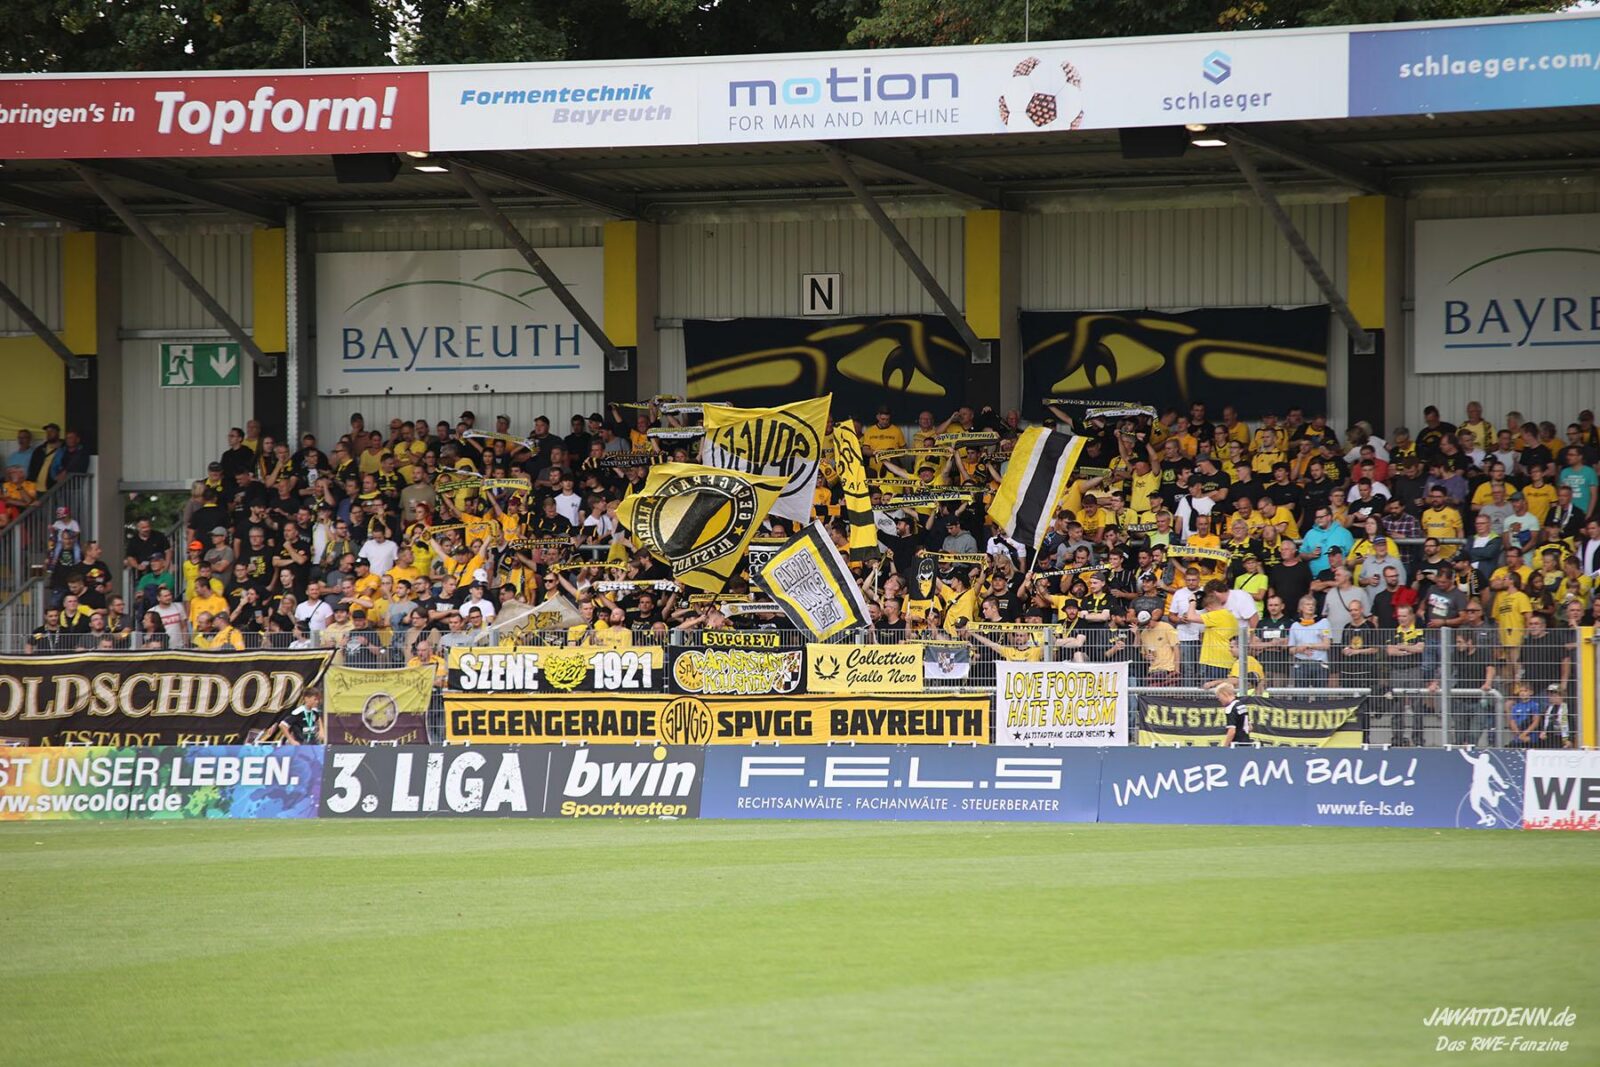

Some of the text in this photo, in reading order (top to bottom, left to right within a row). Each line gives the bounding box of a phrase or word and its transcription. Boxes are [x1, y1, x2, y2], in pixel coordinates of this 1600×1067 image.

[460, 83, 654, 106] Formentechnik
[728, 67, 960, 107] motion
[112, 102, 134, 122] in
[154, 86, 398, 145] Topform!
[552, 104, 672, 126] Bayreuth
[1162, 90, 1272, 113] schlaeger
[728, 107, 960, 132] FOR MAN AND MACHINE
[810, 277, 833, 310] N
[342, 323, 580, 372] BAYREUTH
[706, 632, 776, 647] SUPCREW
[459, 651, 653, 690] SZENE 1921
[846, 648, 916, 669] Collettivo
[846, 668, 917, 687] Giallo Nero
[1005, 670, 1119, 699] LOVE FOOTBALL
[451, 709, 982, 738] GEGENGERADE SPVGG BAYREUTH
[1007, 699, 1118, 727] HATE RACISM
[40, 756, 160, 787] UNSER
[170, 756, 300, 786] LEBEN.
[326, 751, 527, 813] 3. LIGA
[562, 746, 696, 797] bwin
[1113, 757, 1417, 807] IMMER AM BALL!
[560, 800, 687, 818] Sportwetten
[737, 795, 1059, 812] RECHTSANWÄLTE FACHANWÄLTE STEUERBERATER
[1317, 800, 1415, 818] www.fe-ls.de
